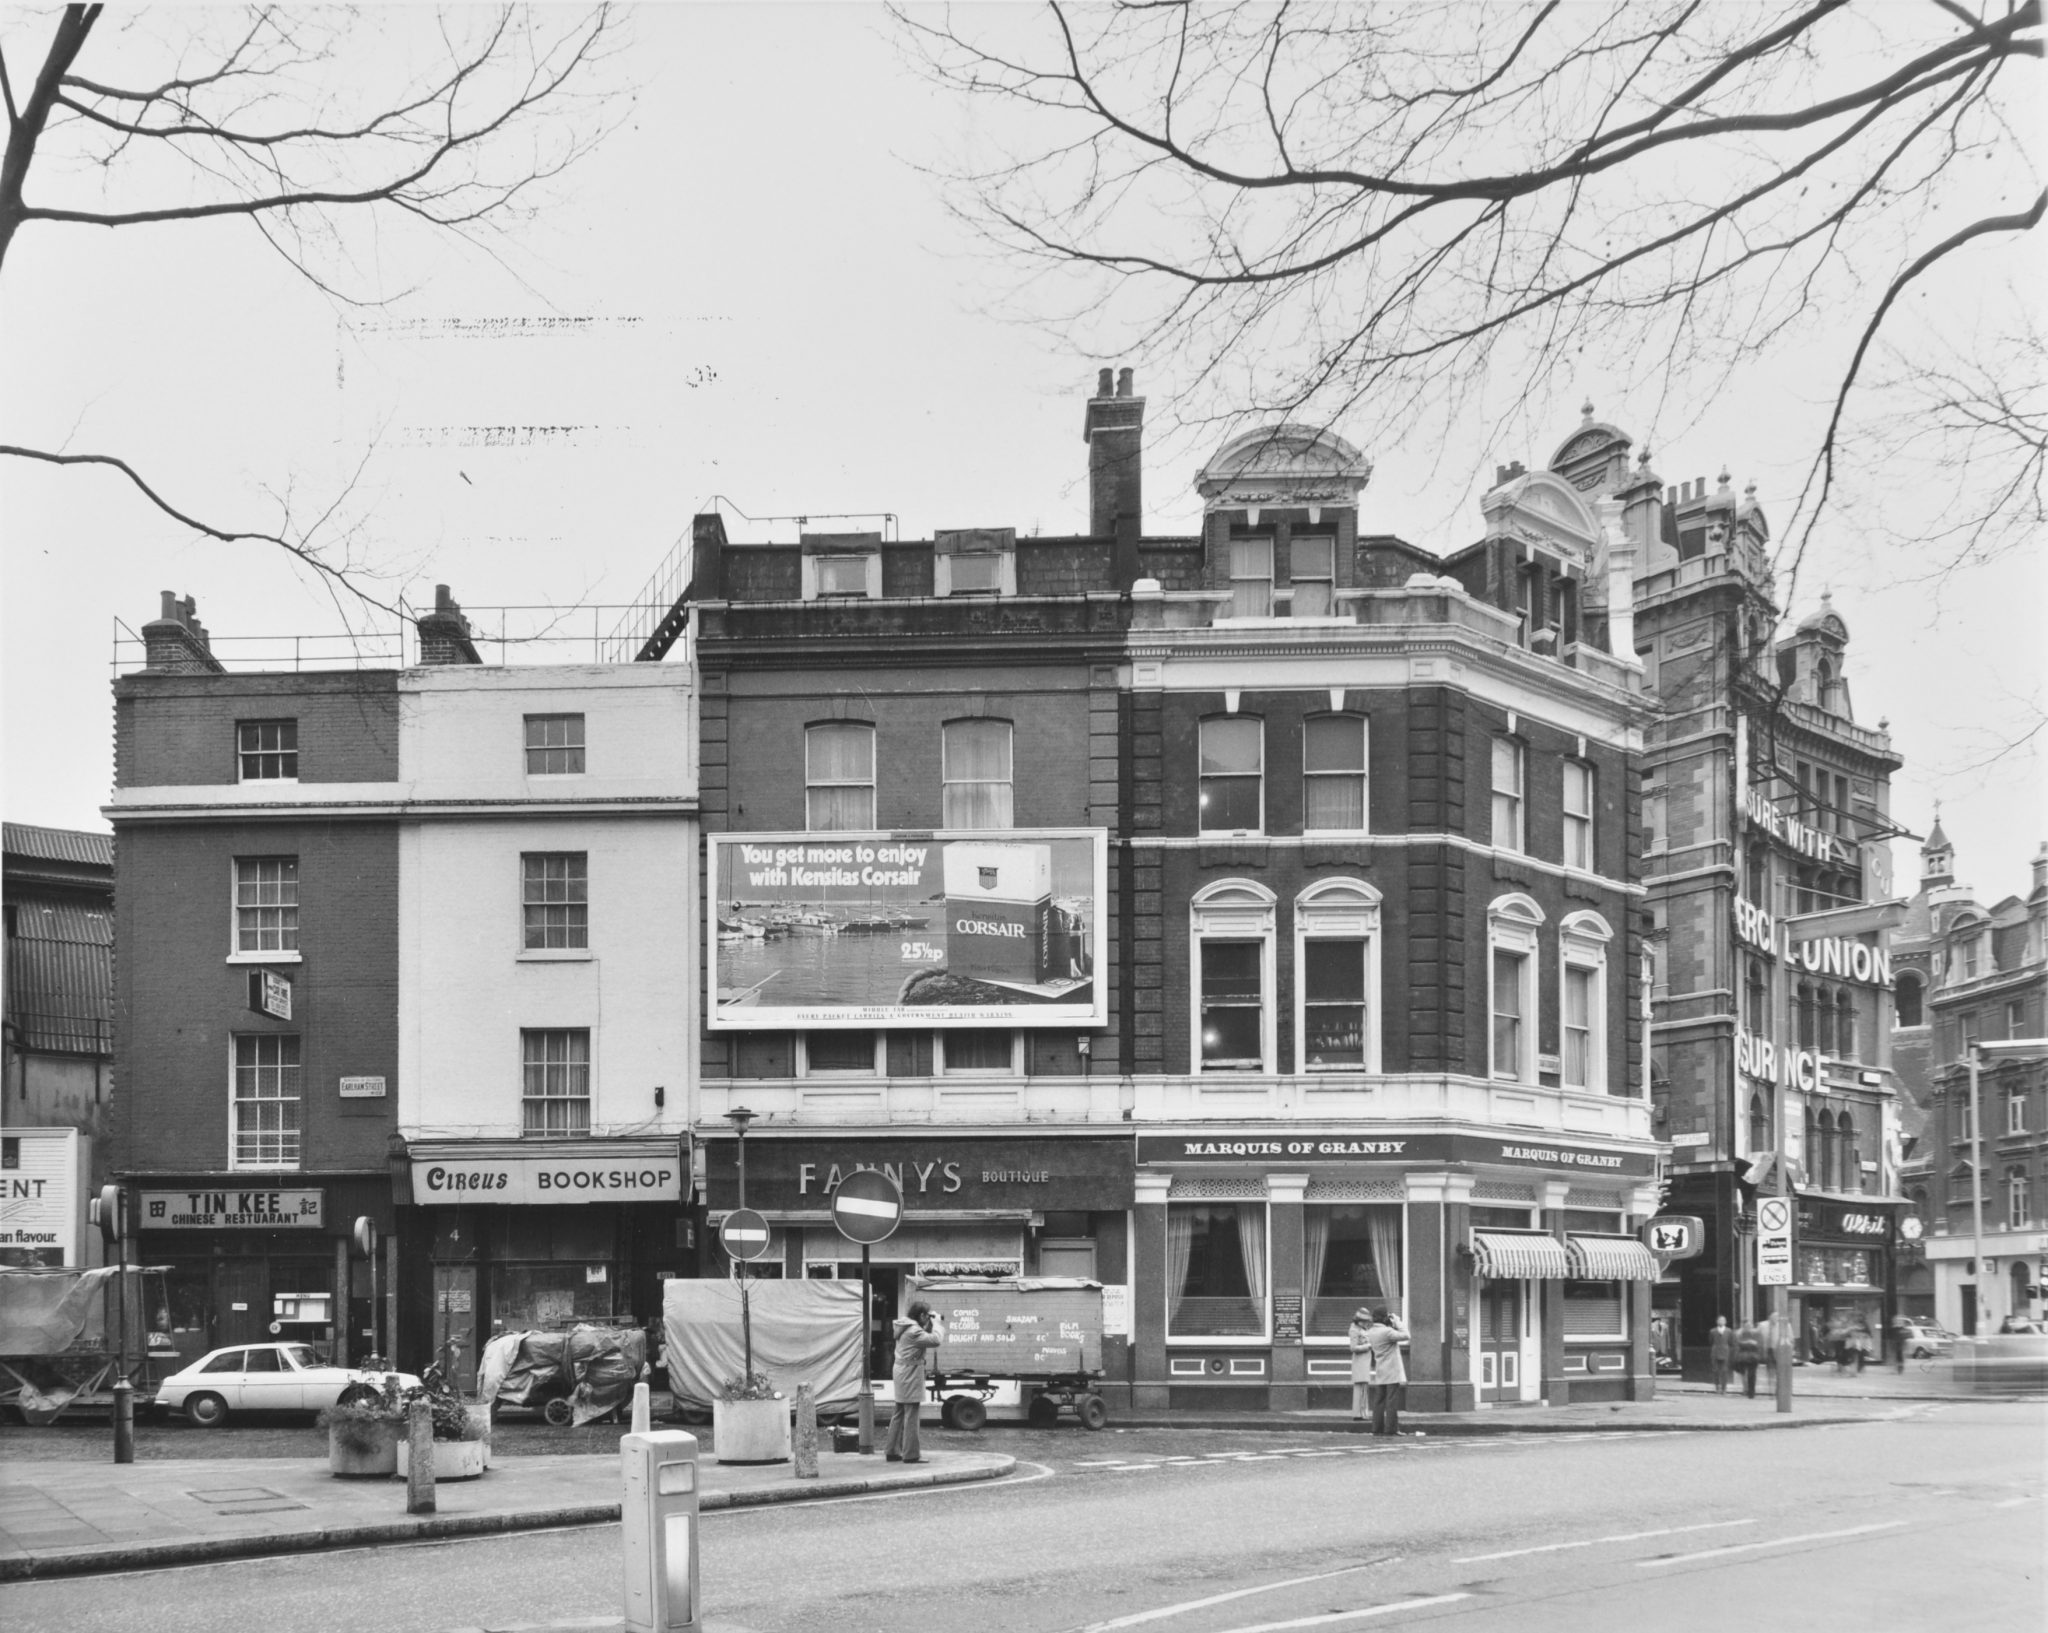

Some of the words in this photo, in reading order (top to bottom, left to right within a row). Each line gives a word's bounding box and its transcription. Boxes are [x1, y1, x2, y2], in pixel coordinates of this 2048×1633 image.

[1786, 816, 1831, 862] WITH
[740, 844, 773, 864] You
[775, 845, 805, 867] get
[807, 848, 853, 864] more
[855, 845, 875, 863] to
[877, 843, 928, 867] enjoy
[749, 867, 788, 886] with
[791, 866, 860, 886] Kensitas
[861, 865, 922, 886] Corsair
[956, 919, 1027, 939] CORSAIR
[1802, 936, 1890, 986] UNION
[1184, 1142, 1283, 1155] MARQUIS
[1287, 1142, 1315, 1154] OF
[1318, 1141, 1407, 1154] GRANBY
[1501, 1145, 1559, 1161] MARQUIS
[1560, 1151, 1576, 1164] OF
[1576, 1153, 1624, 1168] GRANBY
[537, 1170, 672, 1189] BOOKSHOP
[981, 1170, 1049, 1183] BOUTIQUE
[149, 1200, 167, 1218] 田
[187, 1193, 226, 1214] TIN
[238, 1193, 280, 1214] KEE
[299, 1197, 318, 1216] 記
[171, 1213, 216, 1225] CHINESE
[224, 1212, 299, 1225] RESTUARANT
[449, 1228, 460, 1241] 4
[1763, 1274, 1787, 1282] ENDS
[949, 1321, 980, 1330] RECORDS
[948, 1333, 978, 1343] BOUGHT
[980, 1333, 995, 1342] AND
[996, 1333, 1016, 1342] SOLD
